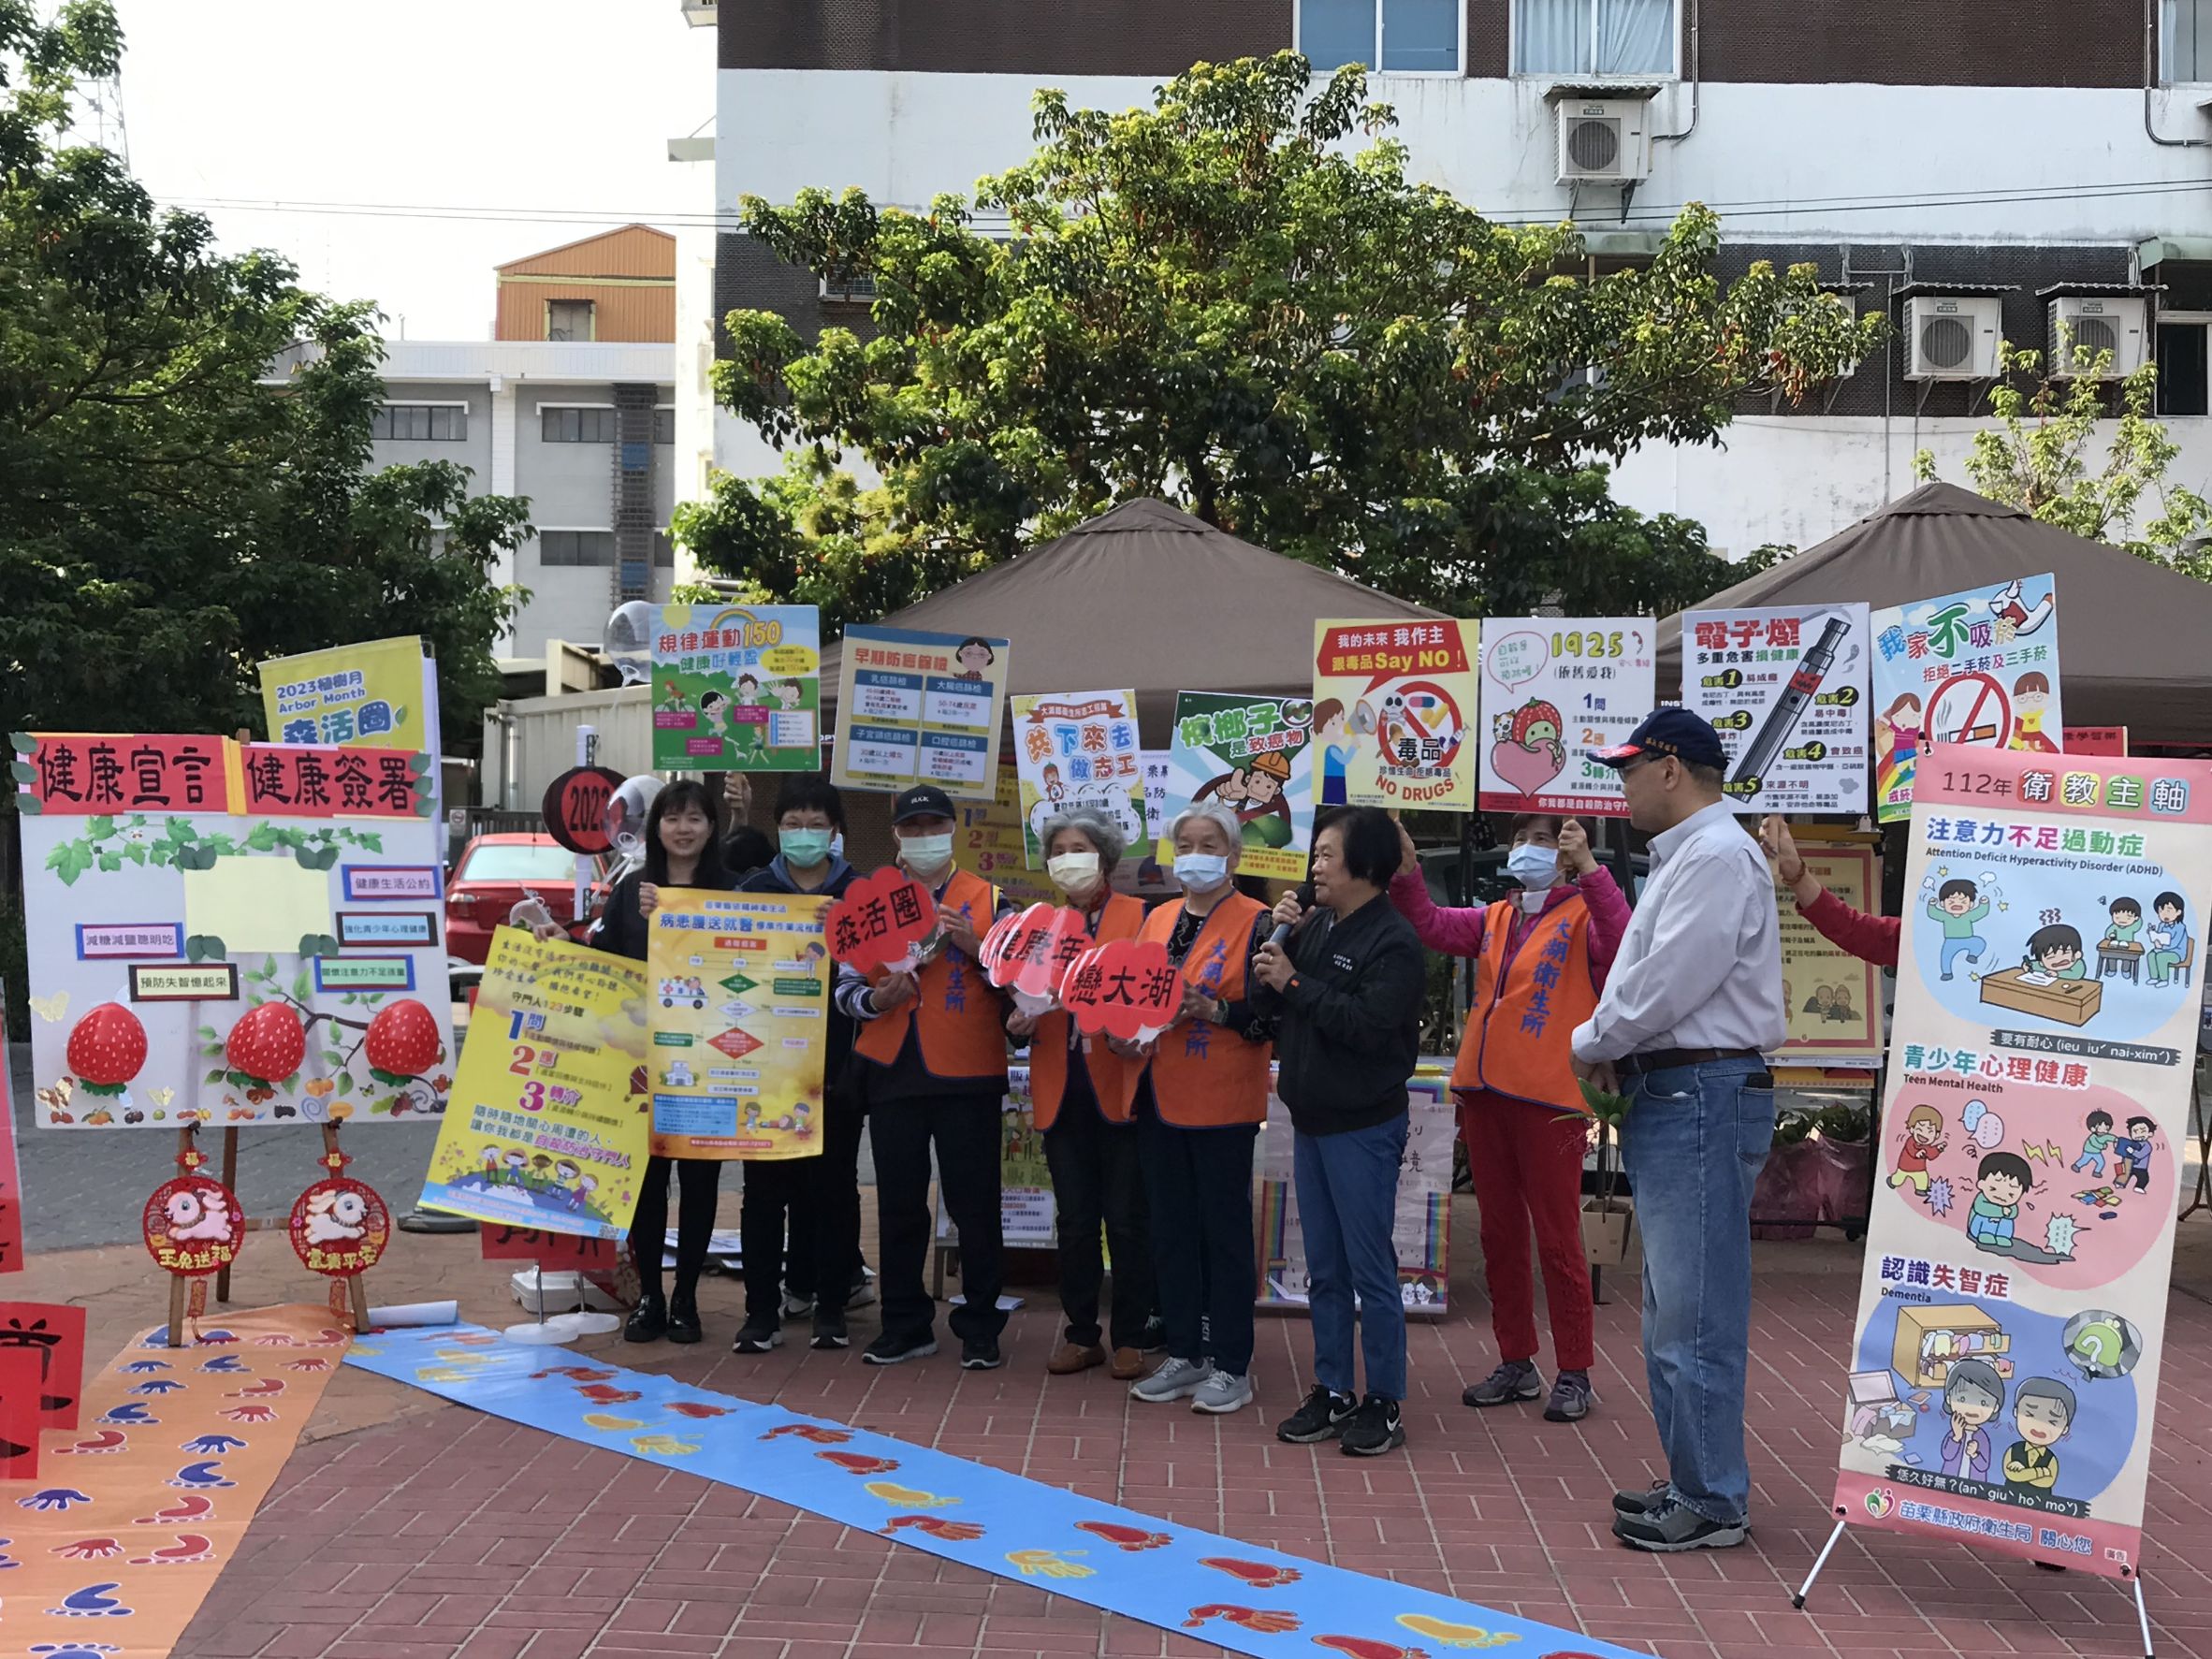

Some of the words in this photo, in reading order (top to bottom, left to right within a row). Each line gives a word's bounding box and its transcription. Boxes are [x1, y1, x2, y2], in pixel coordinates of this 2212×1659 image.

[659, 619, 782, 653] 規律運動150
[1337, 632, 1389, 648] 我的未來
[1393, 625, 1445, 647] 我作主
[1551, 631, 1623, 659] 1925
[1877, 606, 2017, 661] 我家不吸菸
[680, 648, 759, 672] 健康好輕盈
[855, 648, 949, 672] 早期防癌篩檢
[1697, 648, 1799, 664] 多重危害損健康
[1923, 645, 2048, 683] 拒絕二手菸及三手菸
[277, 671, 363, 699] 2023植樹月
[279, 698, 317, 714] Arbor
[324, 688, 365, 705] Month
[1180, 703, 1279, 747] 檳榔子
[1026, 722, 1133, 763] 共下來去
[1230, 730, 1303, 757] 是致癌物
[1398, 737, 1441, 761] 毒品
[37, 743, 211, 807] 健康宣言
[247, 751, 415, 810] 健康簽署
[1069, 753, 1137, 780] 做志工
[1375, 774, 1397, 795] NO
[1402, 778, 1454, 801] DRUGS
[1766, 779, 1810, 790] 來源不明
[1943, 770, 2013, 797] 112年
[2021, 770, 2187, 812] 衛教主軸
[1926, 816, 2145, 858] 注意力不足過動症
[1926, 846, 1972, 860] Attention
[1974, 850, 2008, 863] Deficit
[2009, 853, 2078, 871] Hyperactivity
[2079, 859, 2124, 873] Disorder
[2125, 863, 2164, 878] (ADHD)
[356, 877, 430, 890] 健康生活公約
[660, 912, 752, 932] 病患護送就醫
[836, 882, 924, 953] 森活圈
[86, 934, 175, 946] 減糖減鹽聰明吃
[993, 926, 1084, 971] 健康年
[140, 976, 227, 989] 預防失智憶起來
[1069, 964, 1176, 1008] 戀大湖
[1520, 917, 1572, 1040] 大湖衛生所
[2001, 1031, 2053, 1050] 要有耐心
[1903, 1043, 2088, 1088] 青少年心理健康
[1904, 1073, 1928, 1087] Teen
[1928, 1075, 1965, 1090] Mental
[1966, 1079, 2003, 1094] Health
[158, 1245, 232, 1271] 玉兔送福
[1881, 1255, 2010, 1299] 認識失智症
[1881, 1286, 1932, 1304] Dementia
[1899, 1501, 2033, 1543] 苗栗縣政府衛生局
[2040, 1528, 2093, 1556] 關心您
